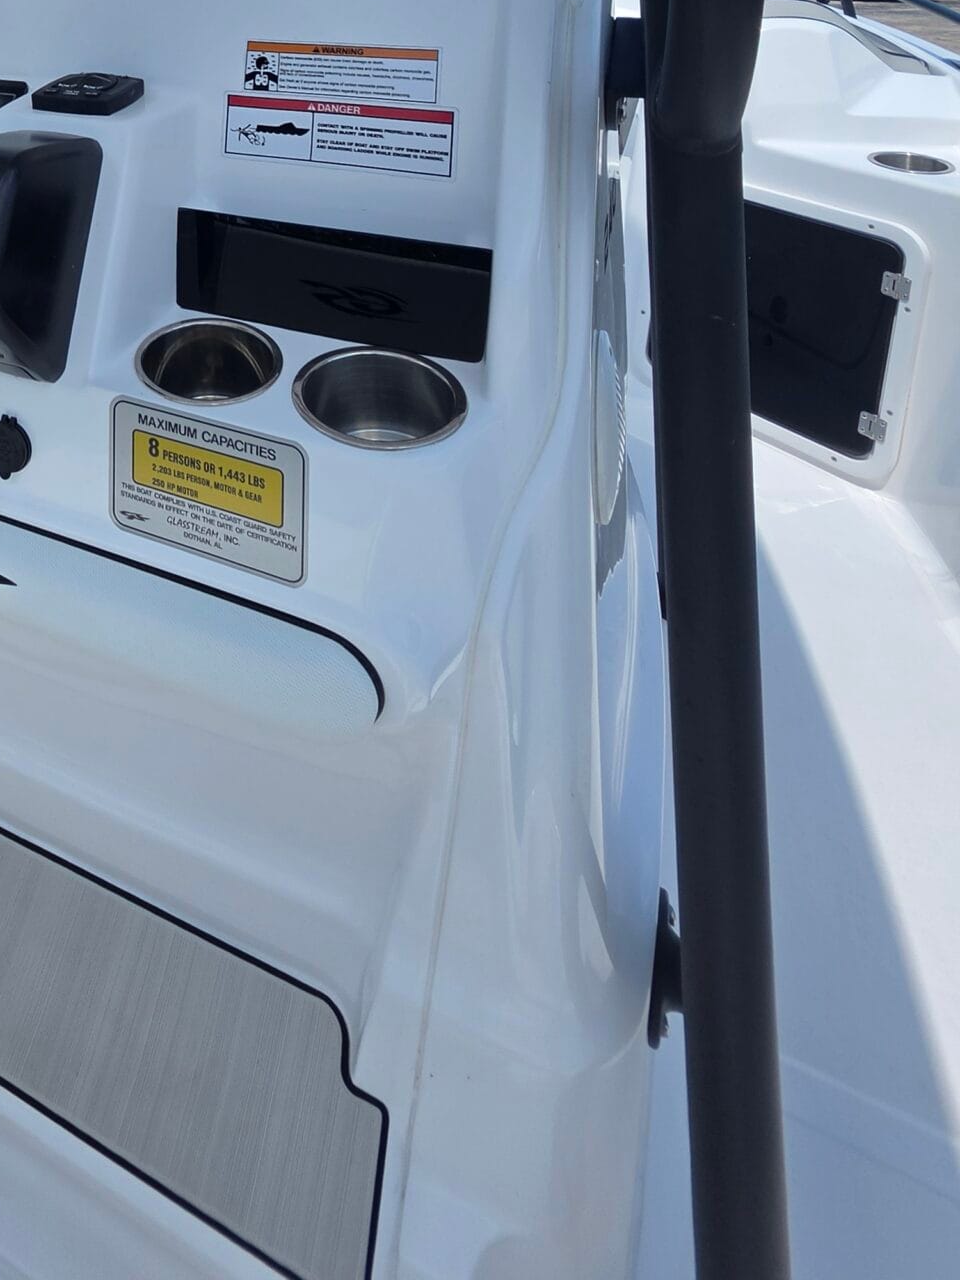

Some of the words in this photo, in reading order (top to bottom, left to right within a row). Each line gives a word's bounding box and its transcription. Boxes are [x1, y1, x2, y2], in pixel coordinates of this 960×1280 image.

[321, 46, 364, 55] WARNING
[317, 103, 361, 115] DANGER
[137, 413, 198, 439] MAXIMUM
[201, 430, 277, 461] CAPACITIES
[148, 437, 160, 457] 8
[162, 449, 201, 471] PERSONS
[203, 461, 216, 475] OR
[218, 466, 246, 483] 1,443
[248, 474, 266, 489] LBS
[152, 478, 165, 488] 250
[166, 481, 175, 491] HP
[176, 485, 199, 498] MOTOR
[173, 469, 185, 480] LBS
[214, 482, 237, 496] MOTOR
[237, 489, 243, 497] &
[245, 491, 263, 503] GEAR
[120, 490, 156, 507] STANDARDS
[157, 502, 165, 510] IN
[165, 504, 189, 517] EFFECT
[190, 512, 201, 521] ON
[202, 516, 216, 525] THE
[216, 521, 234, 533] DATE
[235, 526, 245, 535] OF
[246, 530, 297, 552] CERTIFICATION
[121, 482, 135, 492] THIS
[136, 486, 153, 497] BOAT
[154, 491, 186, 506] COMPLIES
[187, 502, 204, 514] WITH
[205, 506, 217, 517] U.S.
[219, 512, 241, 525] COAST
[243, 520, 267, 533] GUARD
[269, 528, 296, 543] SAFETY
[223, 533, 240, 547] INC.
